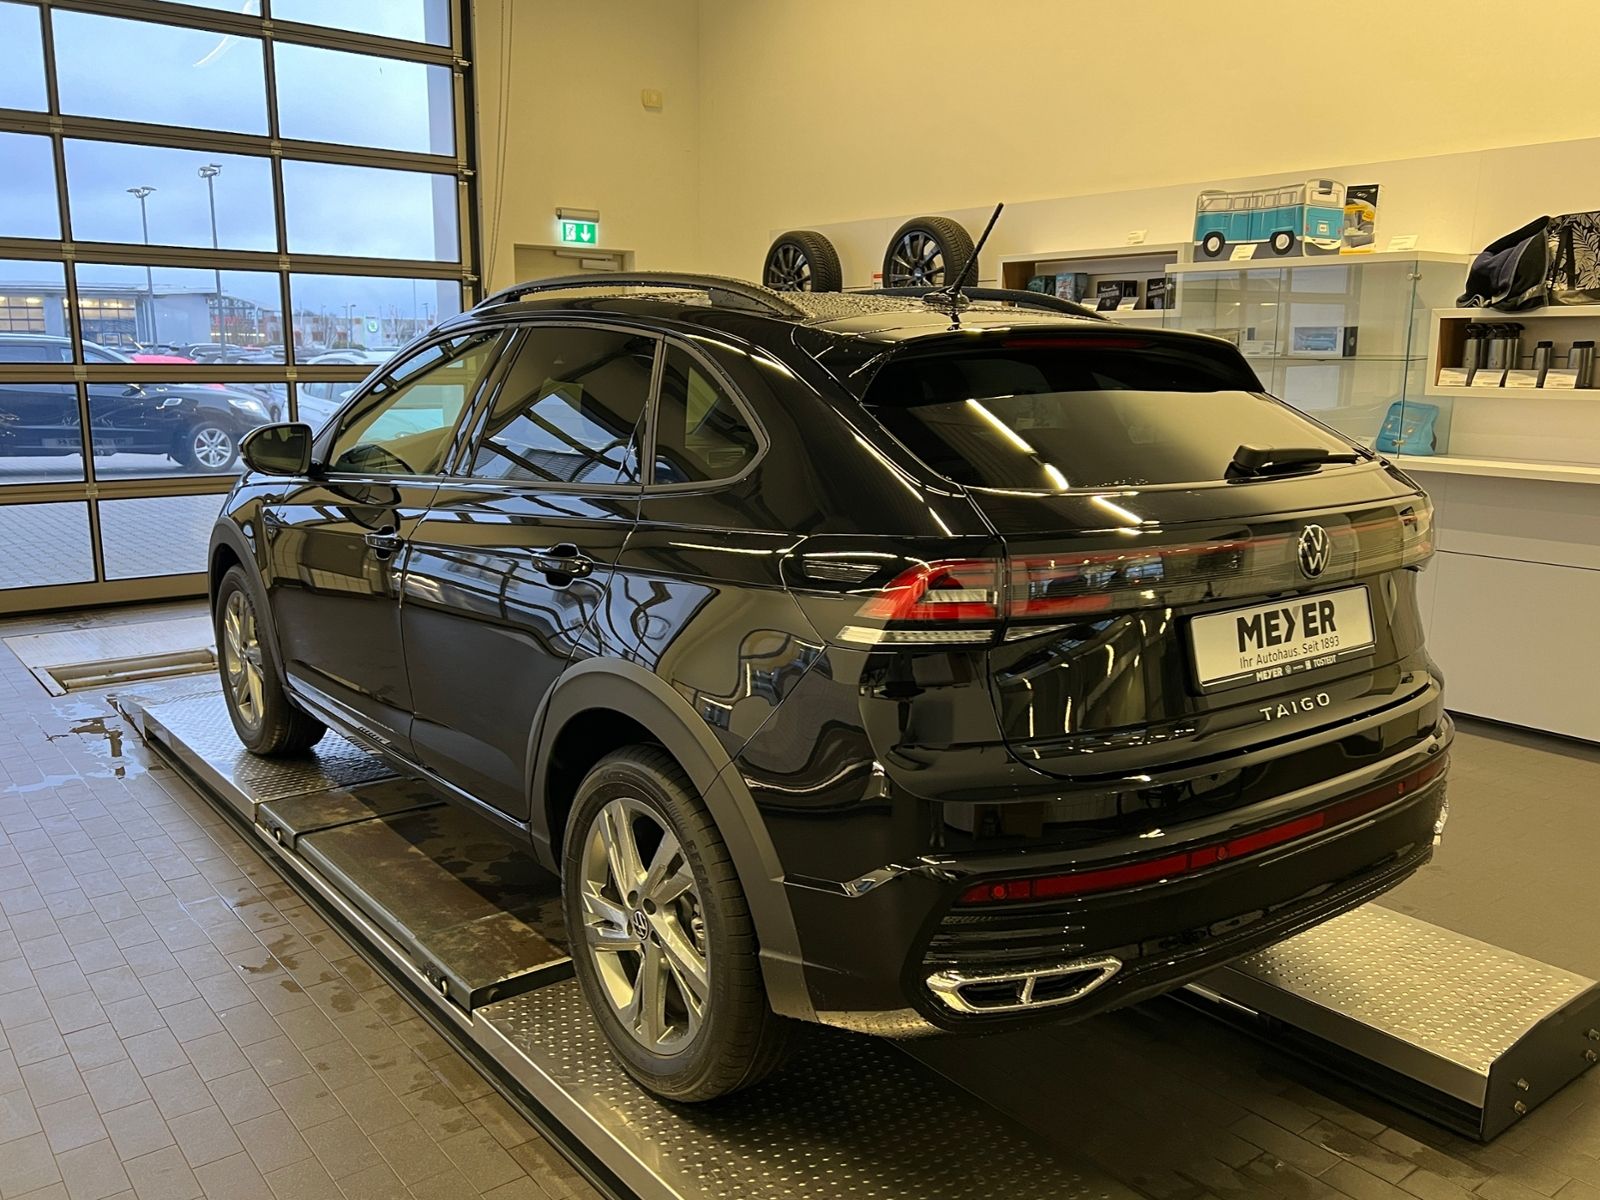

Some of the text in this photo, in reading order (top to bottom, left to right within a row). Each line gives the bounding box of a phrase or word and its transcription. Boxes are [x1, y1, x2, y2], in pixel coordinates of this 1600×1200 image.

[1236, 599, 1337, 653] MEYER
[1239, 635, 1340, 669] Ihr Autohaus. Seit 1893
[1256, 667, 1283, 682] MEYER
[1259, 692, 1330, 721] TAIGO
